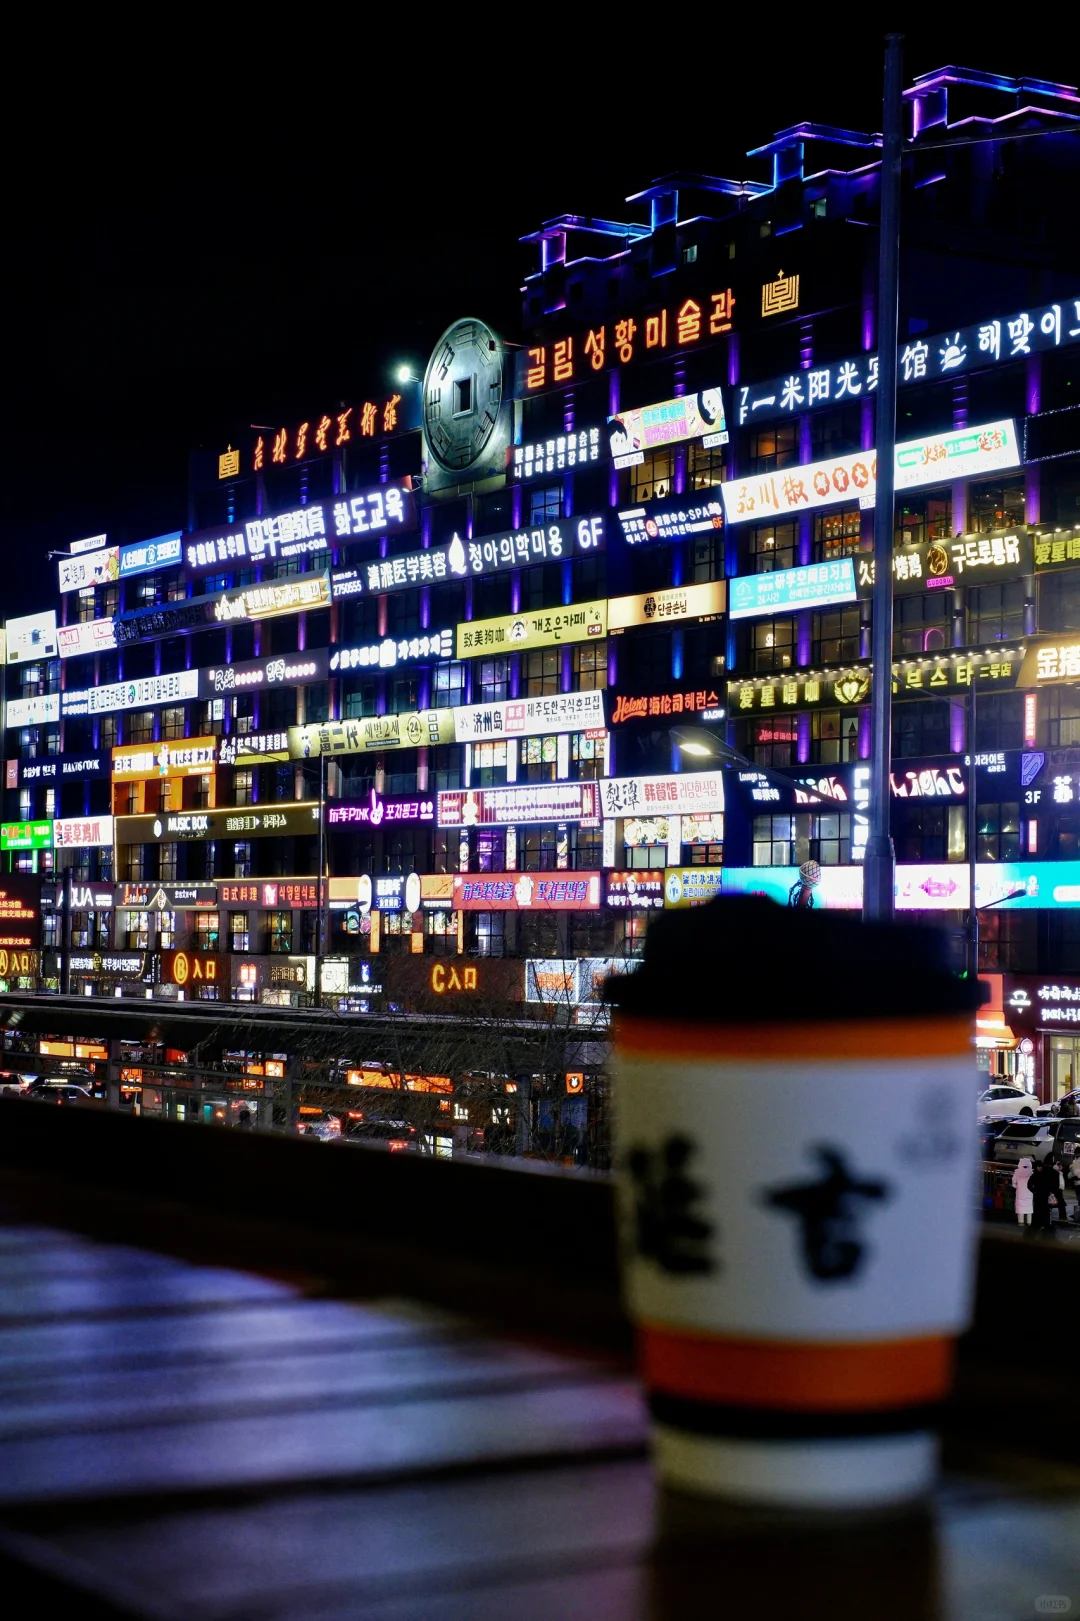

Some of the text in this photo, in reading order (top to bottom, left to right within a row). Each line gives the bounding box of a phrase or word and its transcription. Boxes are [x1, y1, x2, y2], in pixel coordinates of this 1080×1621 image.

[333, 488, 404, 536] 화도교육
[712, 517, 723, 528] 6F
[578, 517, 603, 549] 6F
[468, 526, 563, 573] 청아의학미용
[367, 552, 446, 590] 清雅医学美容
[858, 552, 922, 585] 久烤鸡
[657, 600, 687, 616] 단골손님
[463, 627, 505, 648] 致美狗咖
[979, 663, 1012, 679] 二号店
[649, 693, 683, 716] 海伦司
[739, 679, 820, 709] 爱星唱咖
[364, 719, 400, 740] 재벌2세
[409, 721, 419, 733] 24
[473, 710, 503, 733] 济州岛
[318, 725, 358, 752] 富二代
[1024, 790, 1042, 804] 3F
[168, 816, 208, 832] MUSIC BOX
[222, 886, 258, 901] 日式料理
[432, 964, 477, 993] C入口
